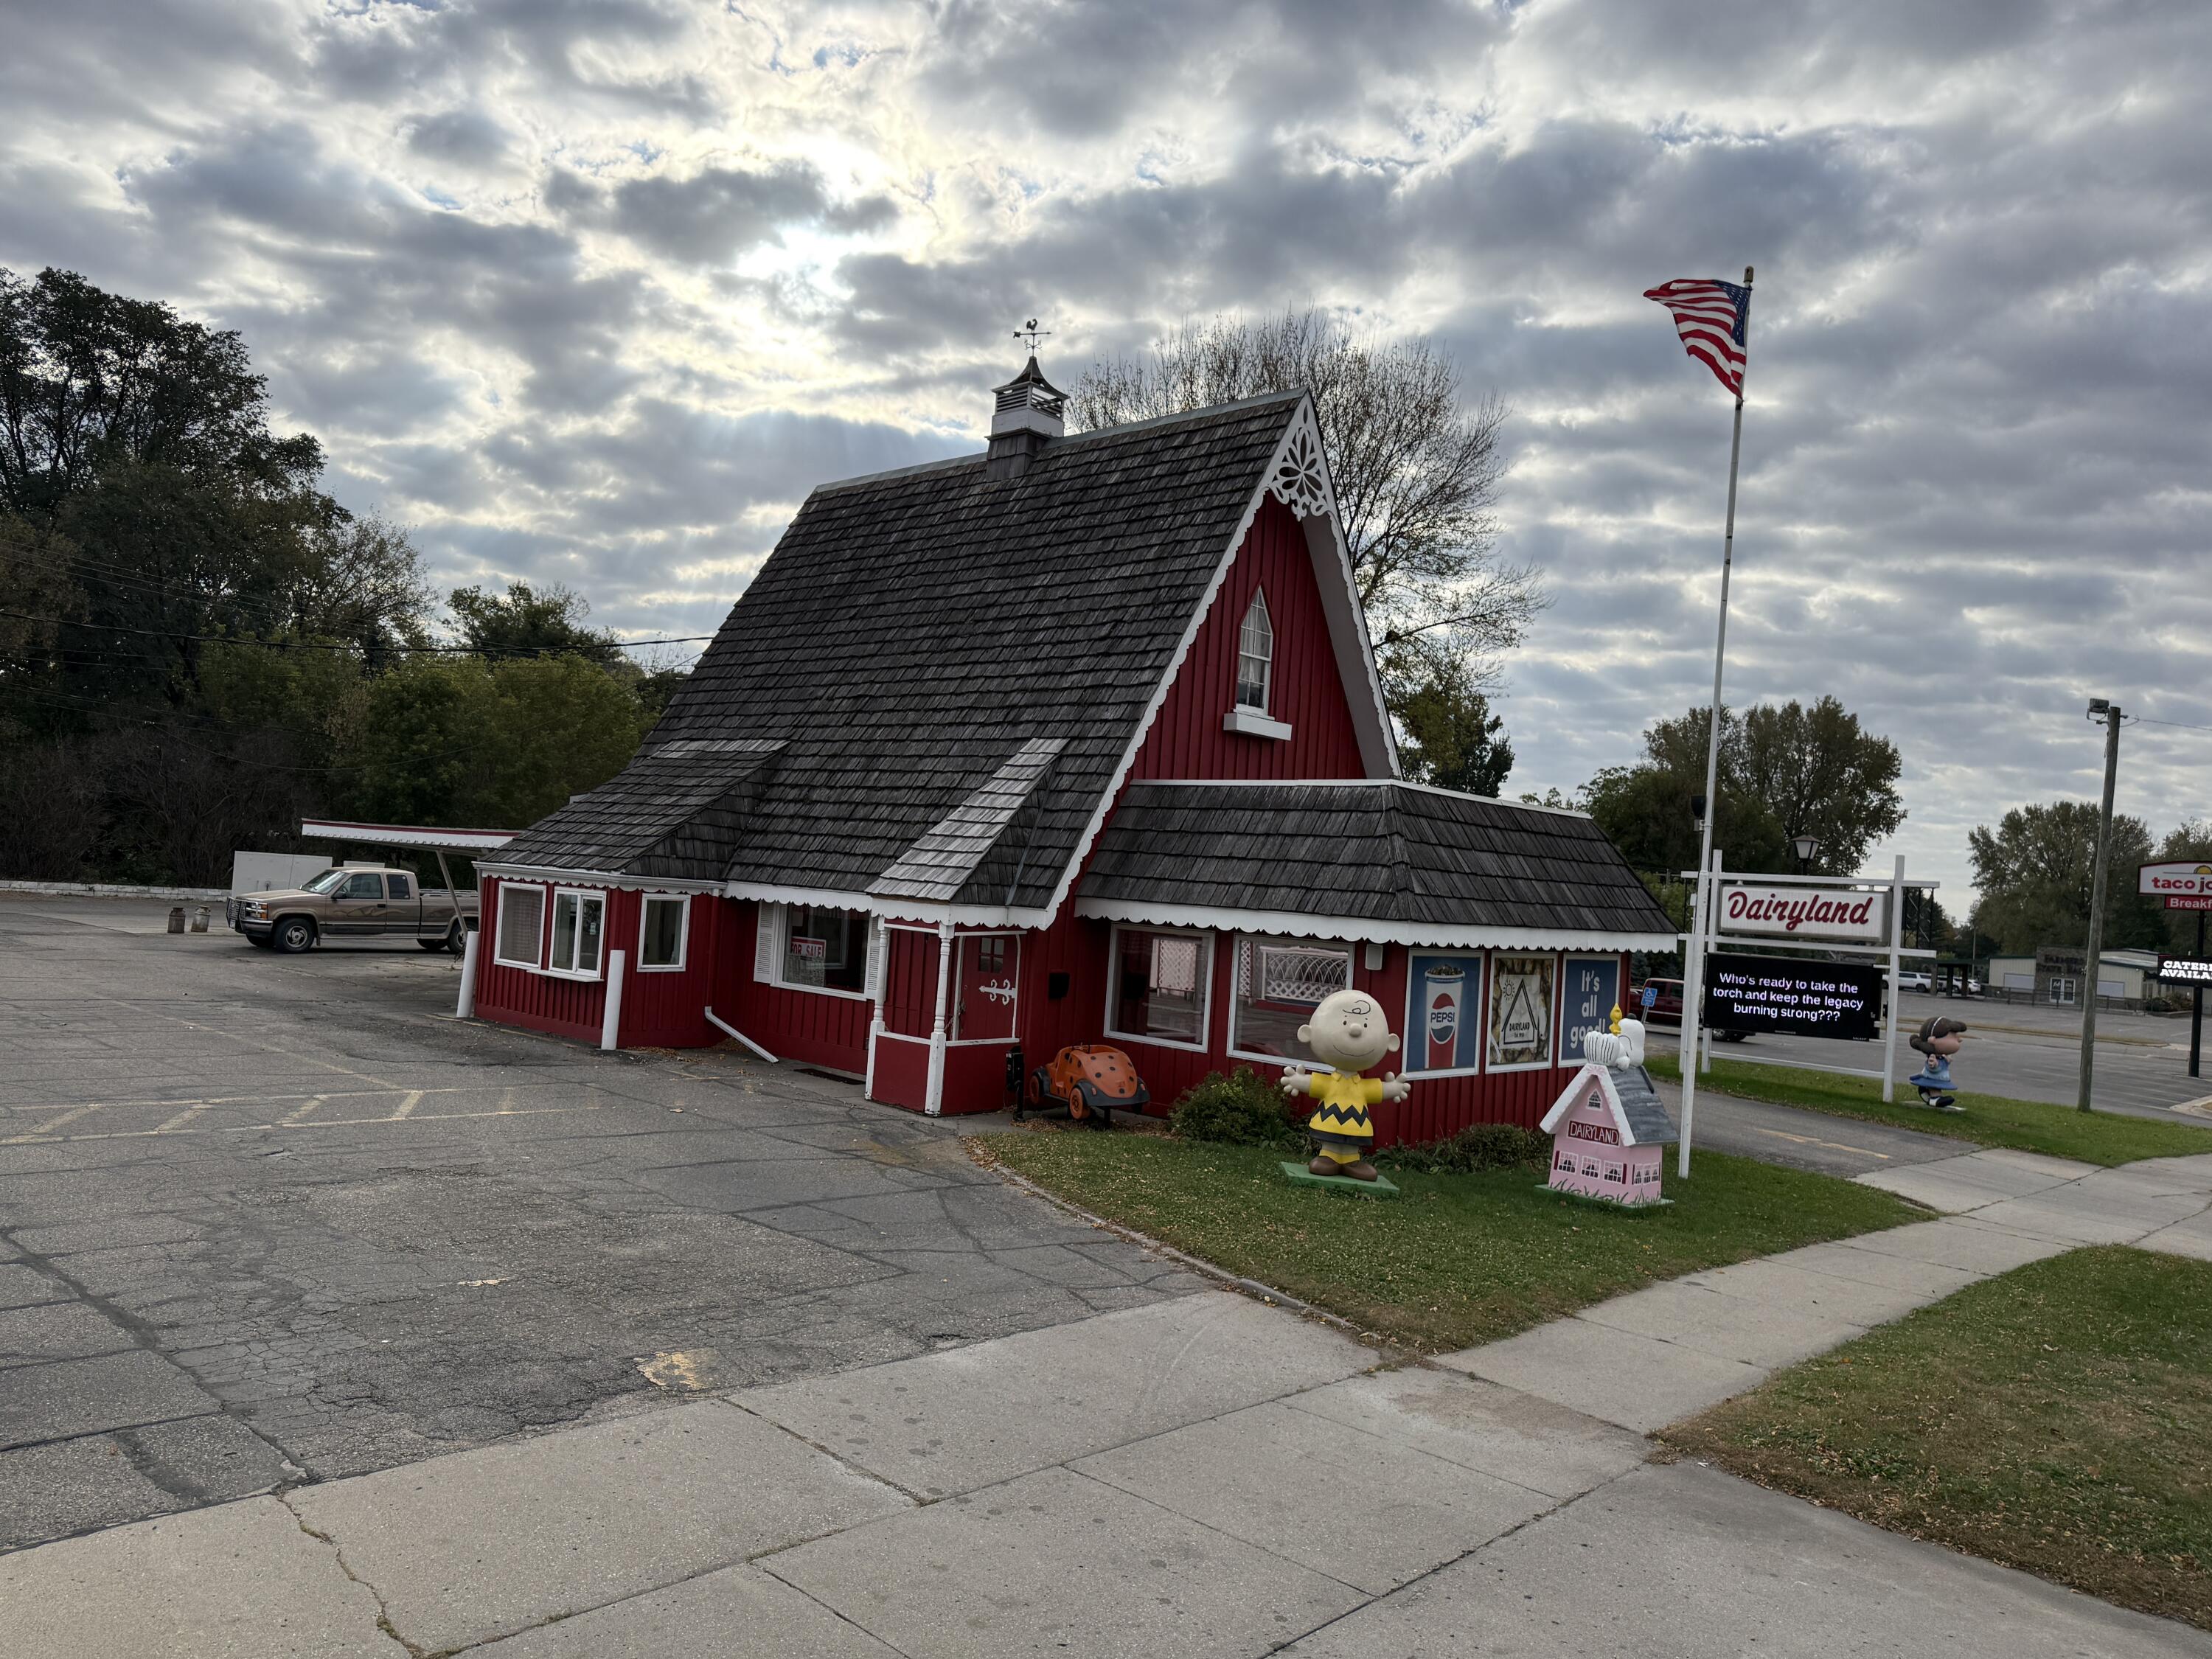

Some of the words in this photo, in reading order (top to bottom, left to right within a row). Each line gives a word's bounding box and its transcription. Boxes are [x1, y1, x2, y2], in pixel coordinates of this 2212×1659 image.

[2152, 877, 2195, 889] taco
[1728, 891, 1874, 931] Dairyland
[790, 944, 802, 955] FOR
[806, 945, 822, 958] SALE
[1582, 970, 1600, 992] It's
[1719, 973, 1755, 985] Who's
[1759, 978, 1792, 990] ready
[1795, 980, 1806, 989] to
[1811, 981, 1835, 992] take
[1840, 983, 1858, 993] the
[1582, 995, 1597, 1017] all
[1713, 987, 1742, 998] torch
[1745, 990, 1767, 1000] and
[1770, 992, 1798, 1005] keep
[1802, 994, 1820, 1005] the
[1824, 996, 1863, 1011] legacy
[1430, 1012, 1455, 1023] PEPSI
[1733, 1003, 1778, 1018] burning
[1781, 1008, 1840, 1022] strong???
[1509, 1022, 1530, 1032] DAIRYLAND
[1570, 1122, 1618, 1144] DAIRYLAND
